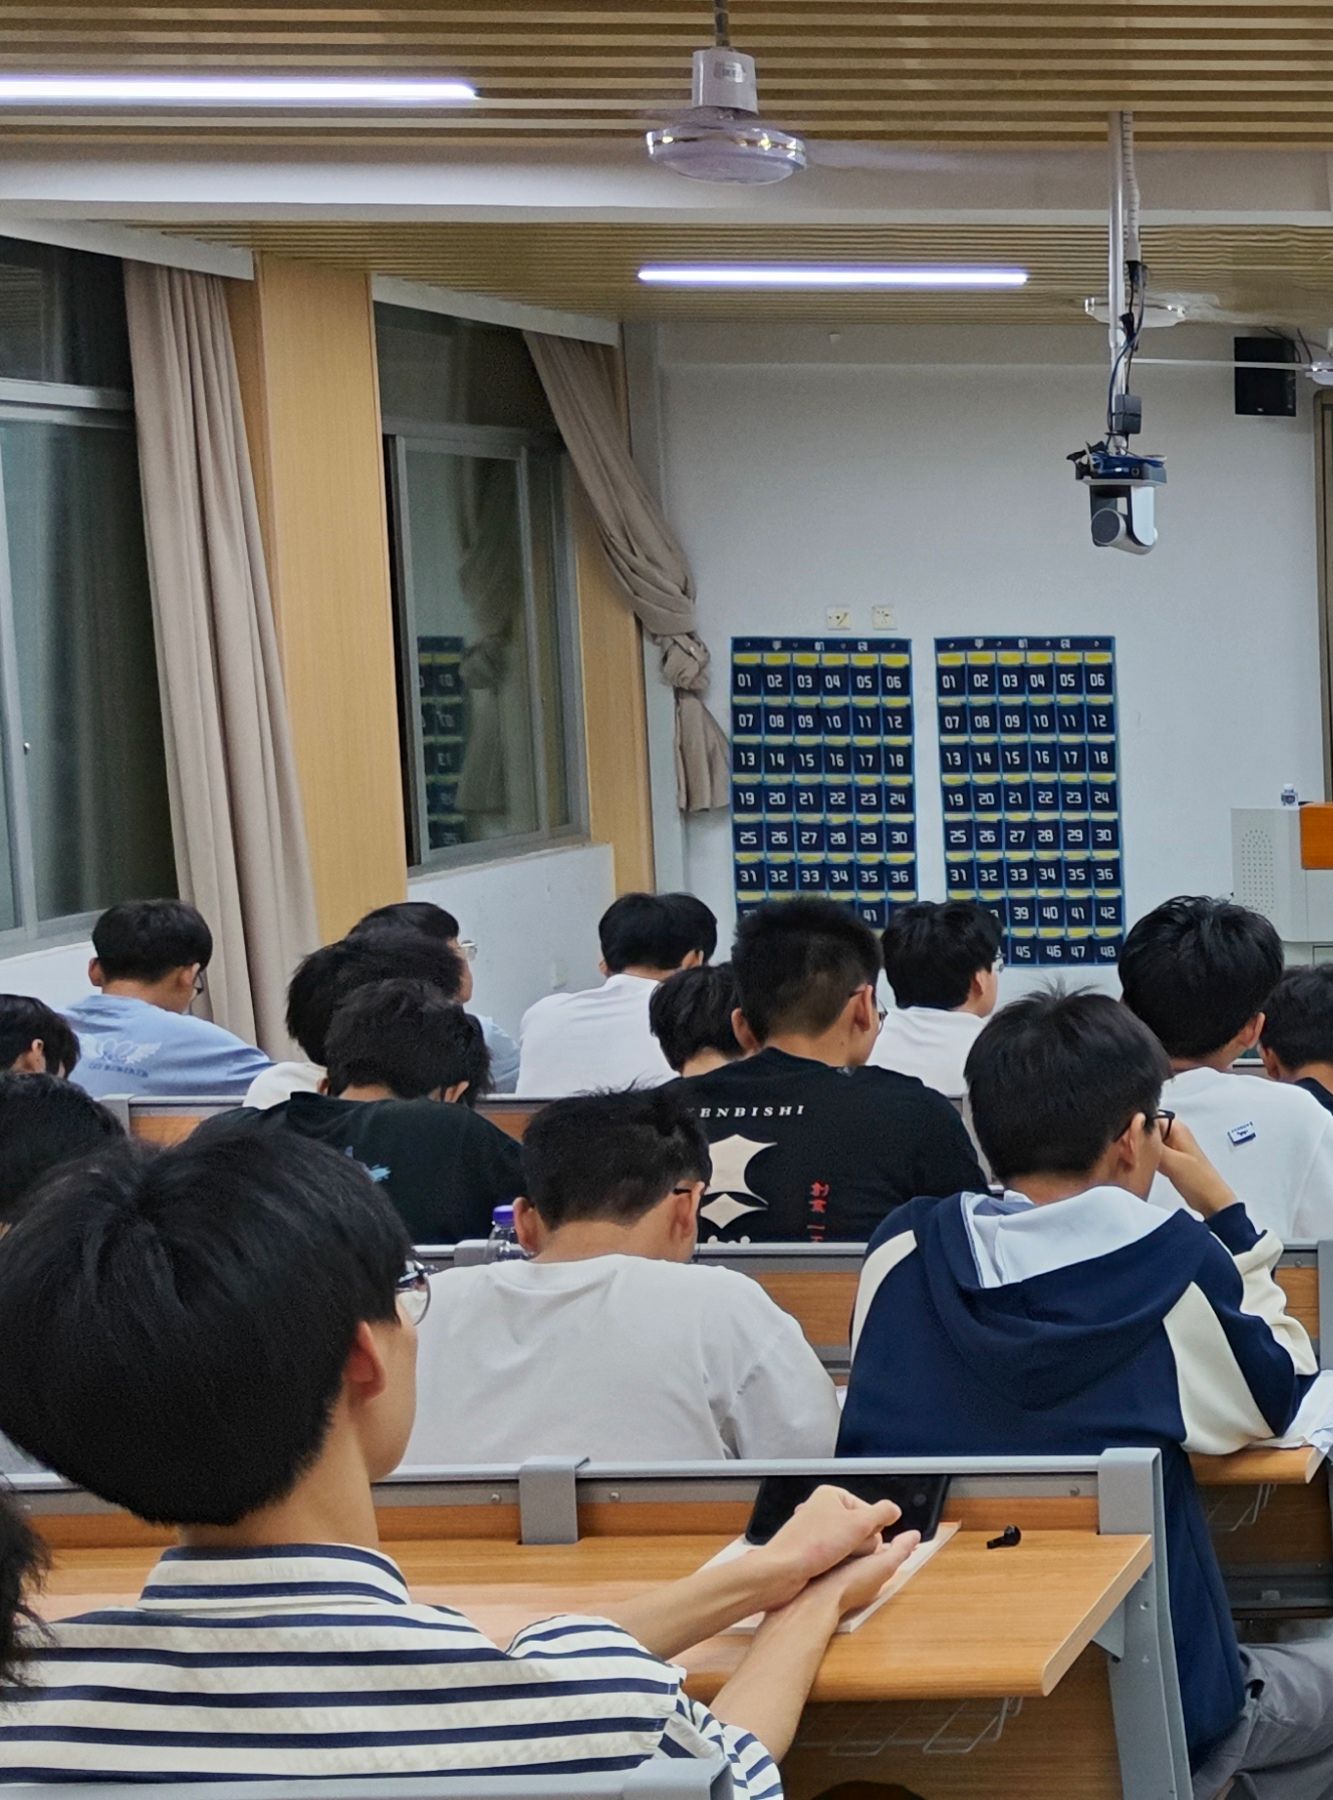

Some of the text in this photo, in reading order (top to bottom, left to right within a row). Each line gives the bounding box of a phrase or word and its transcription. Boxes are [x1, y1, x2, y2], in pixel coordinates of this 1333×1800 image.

[738, 673, 901, 688] 01 02 03 04 05 06
[942, 674, 1105, 688] 01 02 03 04 05 06
[738, 714, 902, 728] 07 08 09 10 11 12
[945, 714, 1107, 728] 07 08 09 10 11 12
[740, 752, 904, 767] 13 14 15 16 17 18
[946, 751, 1108, 765] 13 14 15 16 17 18
[739, 792, 906, 805] 19 20 21 22 23 24
[949, 792, 1109, 806] 19 20 21 22 23 24
[740, 832, 908, 844] 25 26 27 28 29 30
[950, 829, 1112, 843] 25 26 27 28 29 30
[740, 870, 908, 883] 31 32 33 34 35 36
[951, 868, 1113, 881] 31 32 33 34 35 36
[863, 909, 877, 922] 41
[1014, 907, 1116, 919] 39 40 41 42
[1016, 946, 1030, 958] 45
[1047, 945, 1062, 958] 46
[1071, 946, 1085, 957] 47
[1100, 946, 1116, 957] 48
